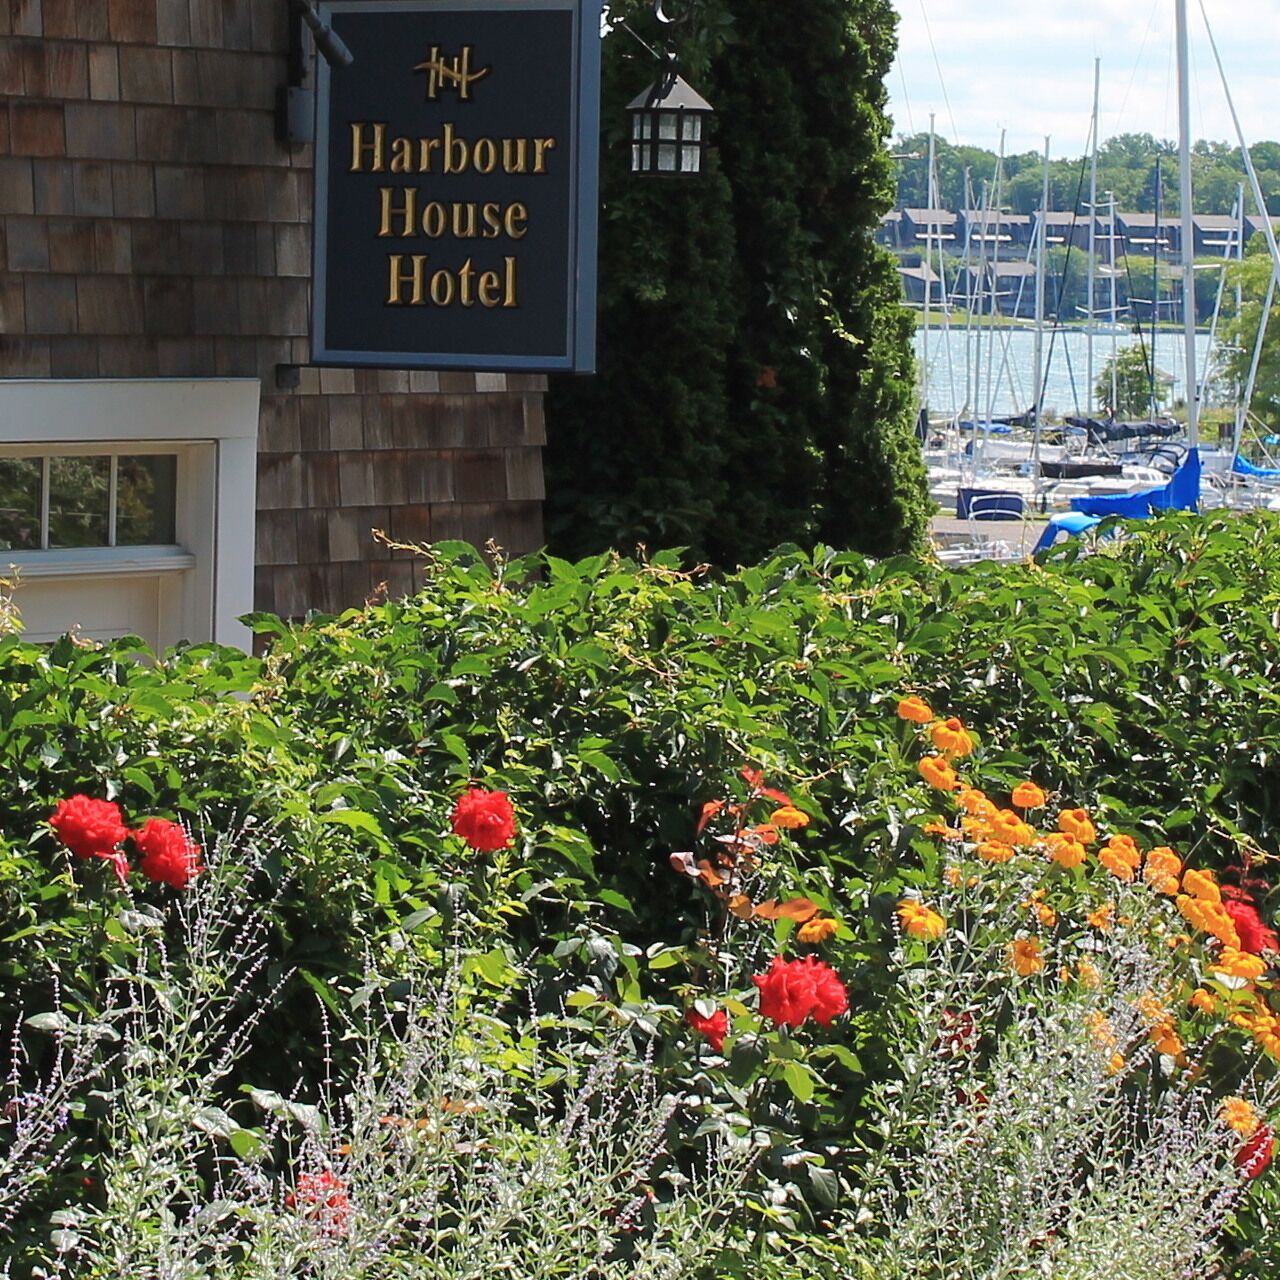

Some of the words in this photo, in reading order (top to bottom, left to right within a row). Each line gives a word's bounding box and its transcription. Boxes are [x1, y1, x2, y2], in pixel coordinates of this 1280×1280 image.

[349, 122, 556, 174] Harbour
[377, 187, 528, 238] House
[386, 255, 518, 307] Hotel
